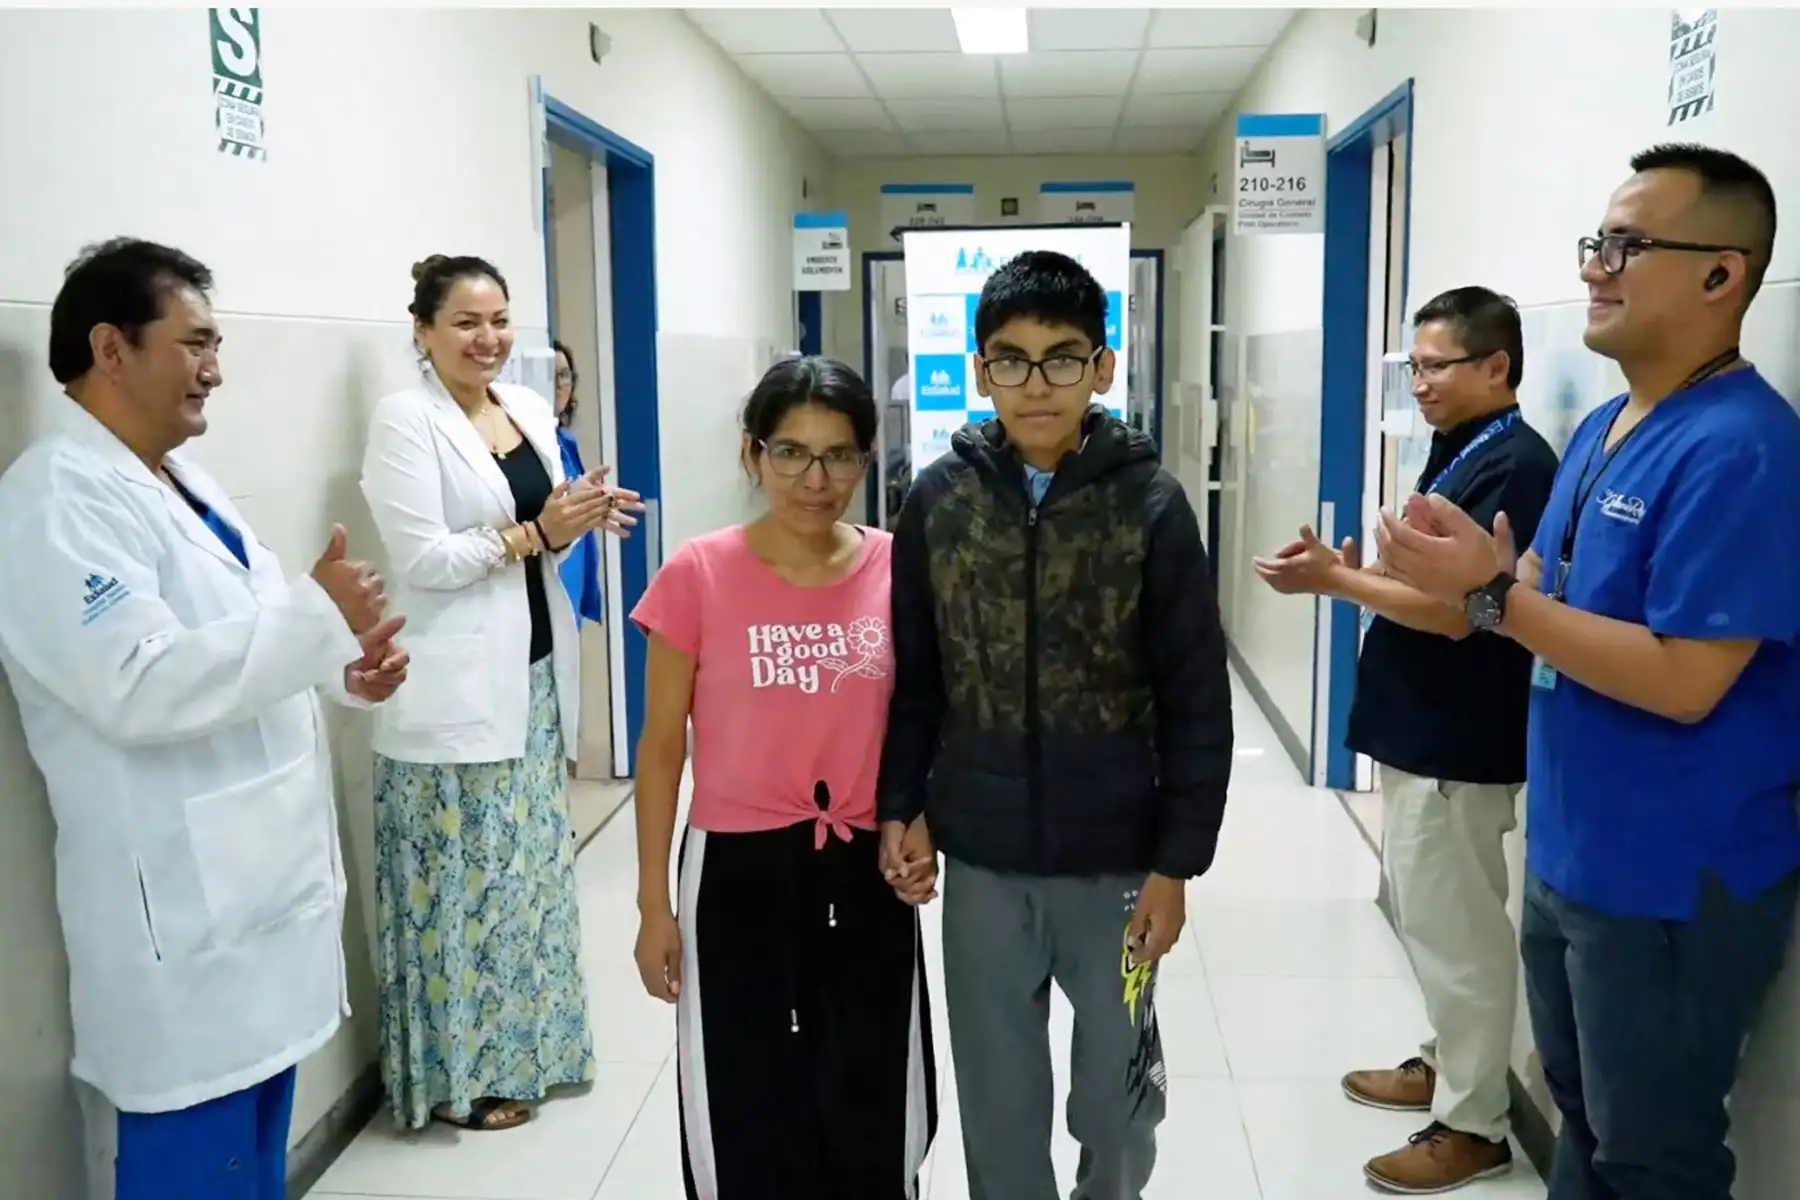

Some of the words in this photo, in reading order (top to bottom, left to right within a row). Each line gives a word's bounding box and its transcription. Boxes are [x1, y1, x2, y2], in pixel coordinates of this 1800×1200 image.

[216, 8, 257, 77] S
[1240, 177, 1307, 192] 210-216
[1276, 196, 1316, 208] General
[748, 624, 824, 654] Have
[827, 623, 844, 637] a
[776, 637, 848, 666] good
[751, 656, 819, 694] Day
